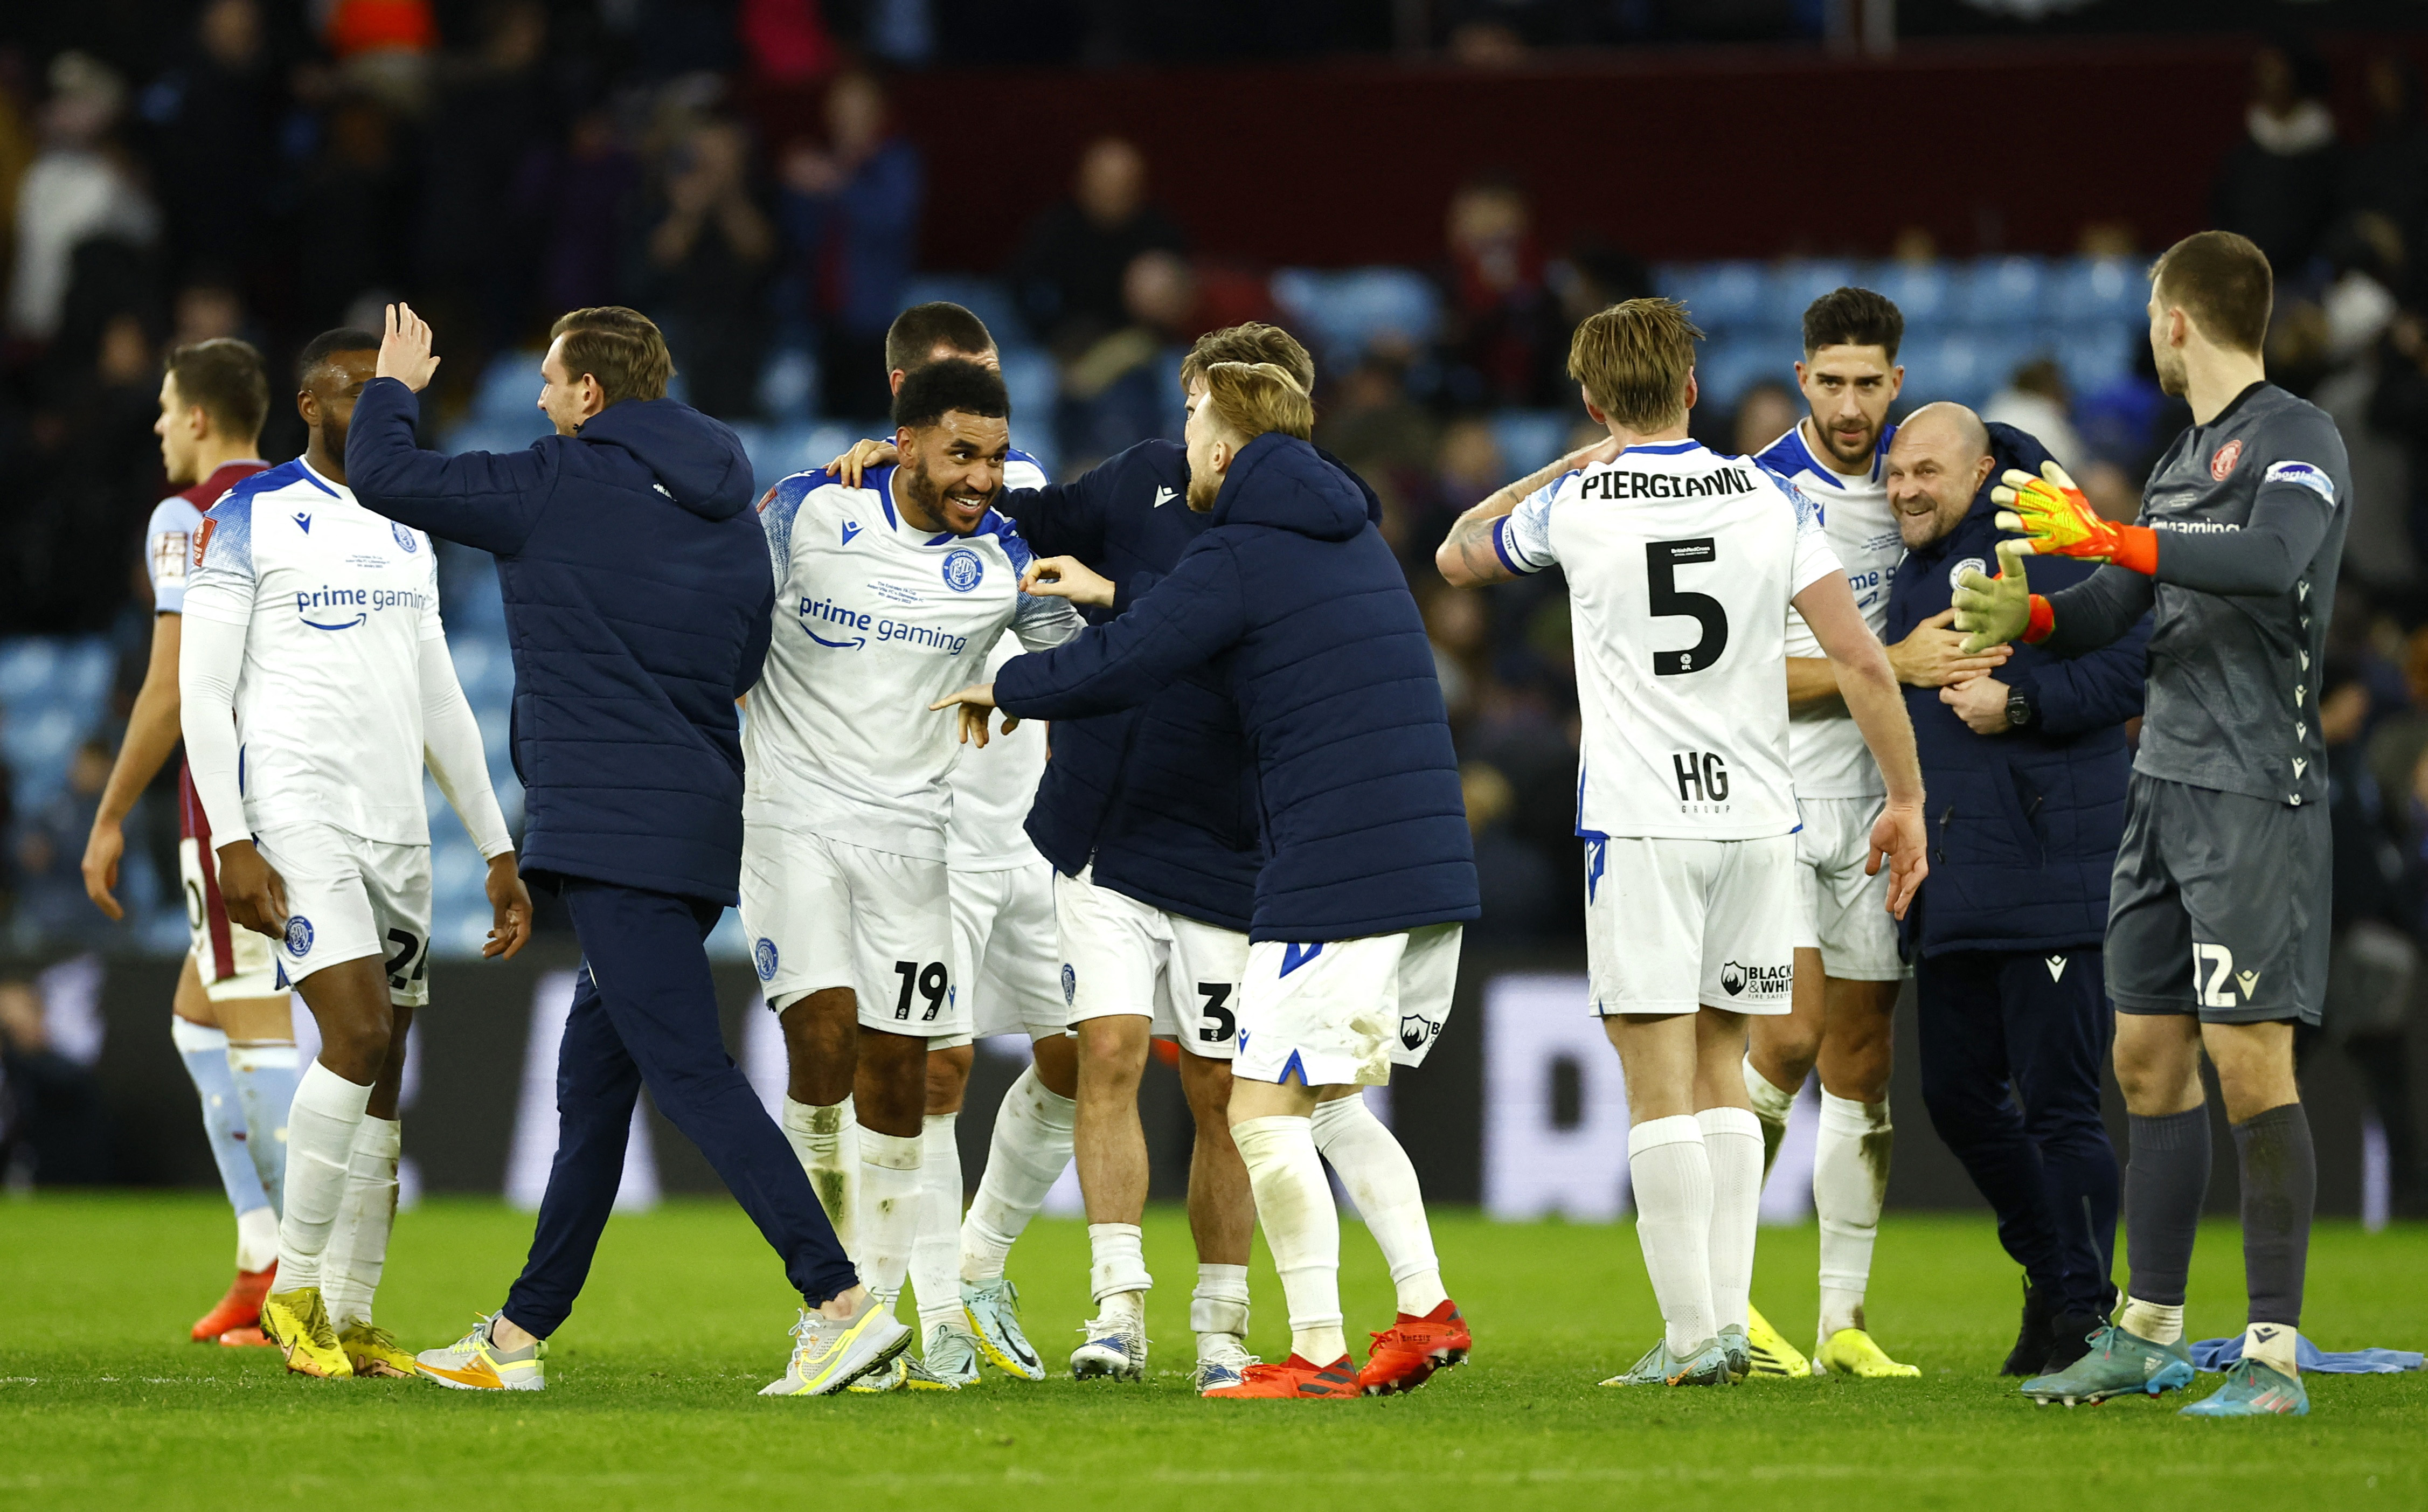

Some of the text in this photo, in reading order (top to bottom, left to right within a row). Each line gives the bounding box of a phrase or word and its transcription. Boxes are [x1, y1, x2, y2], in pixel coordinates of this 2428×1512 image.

[1581, 467, 1758, 500] PIERGIANNI
[297, 585, 426, 612] prime gamin
[1646, 537, 1728, 676] 5
[799, 597, 967, 655] prime gaming
[1673, 752, 1729, 802] HG
[1682, 805, 1730, 813] GROUP
[894, 961, 947, 1021] 19
[1749, 964, 1792, 980] BLACK
[1198, 982, 1240, 1042] 3
